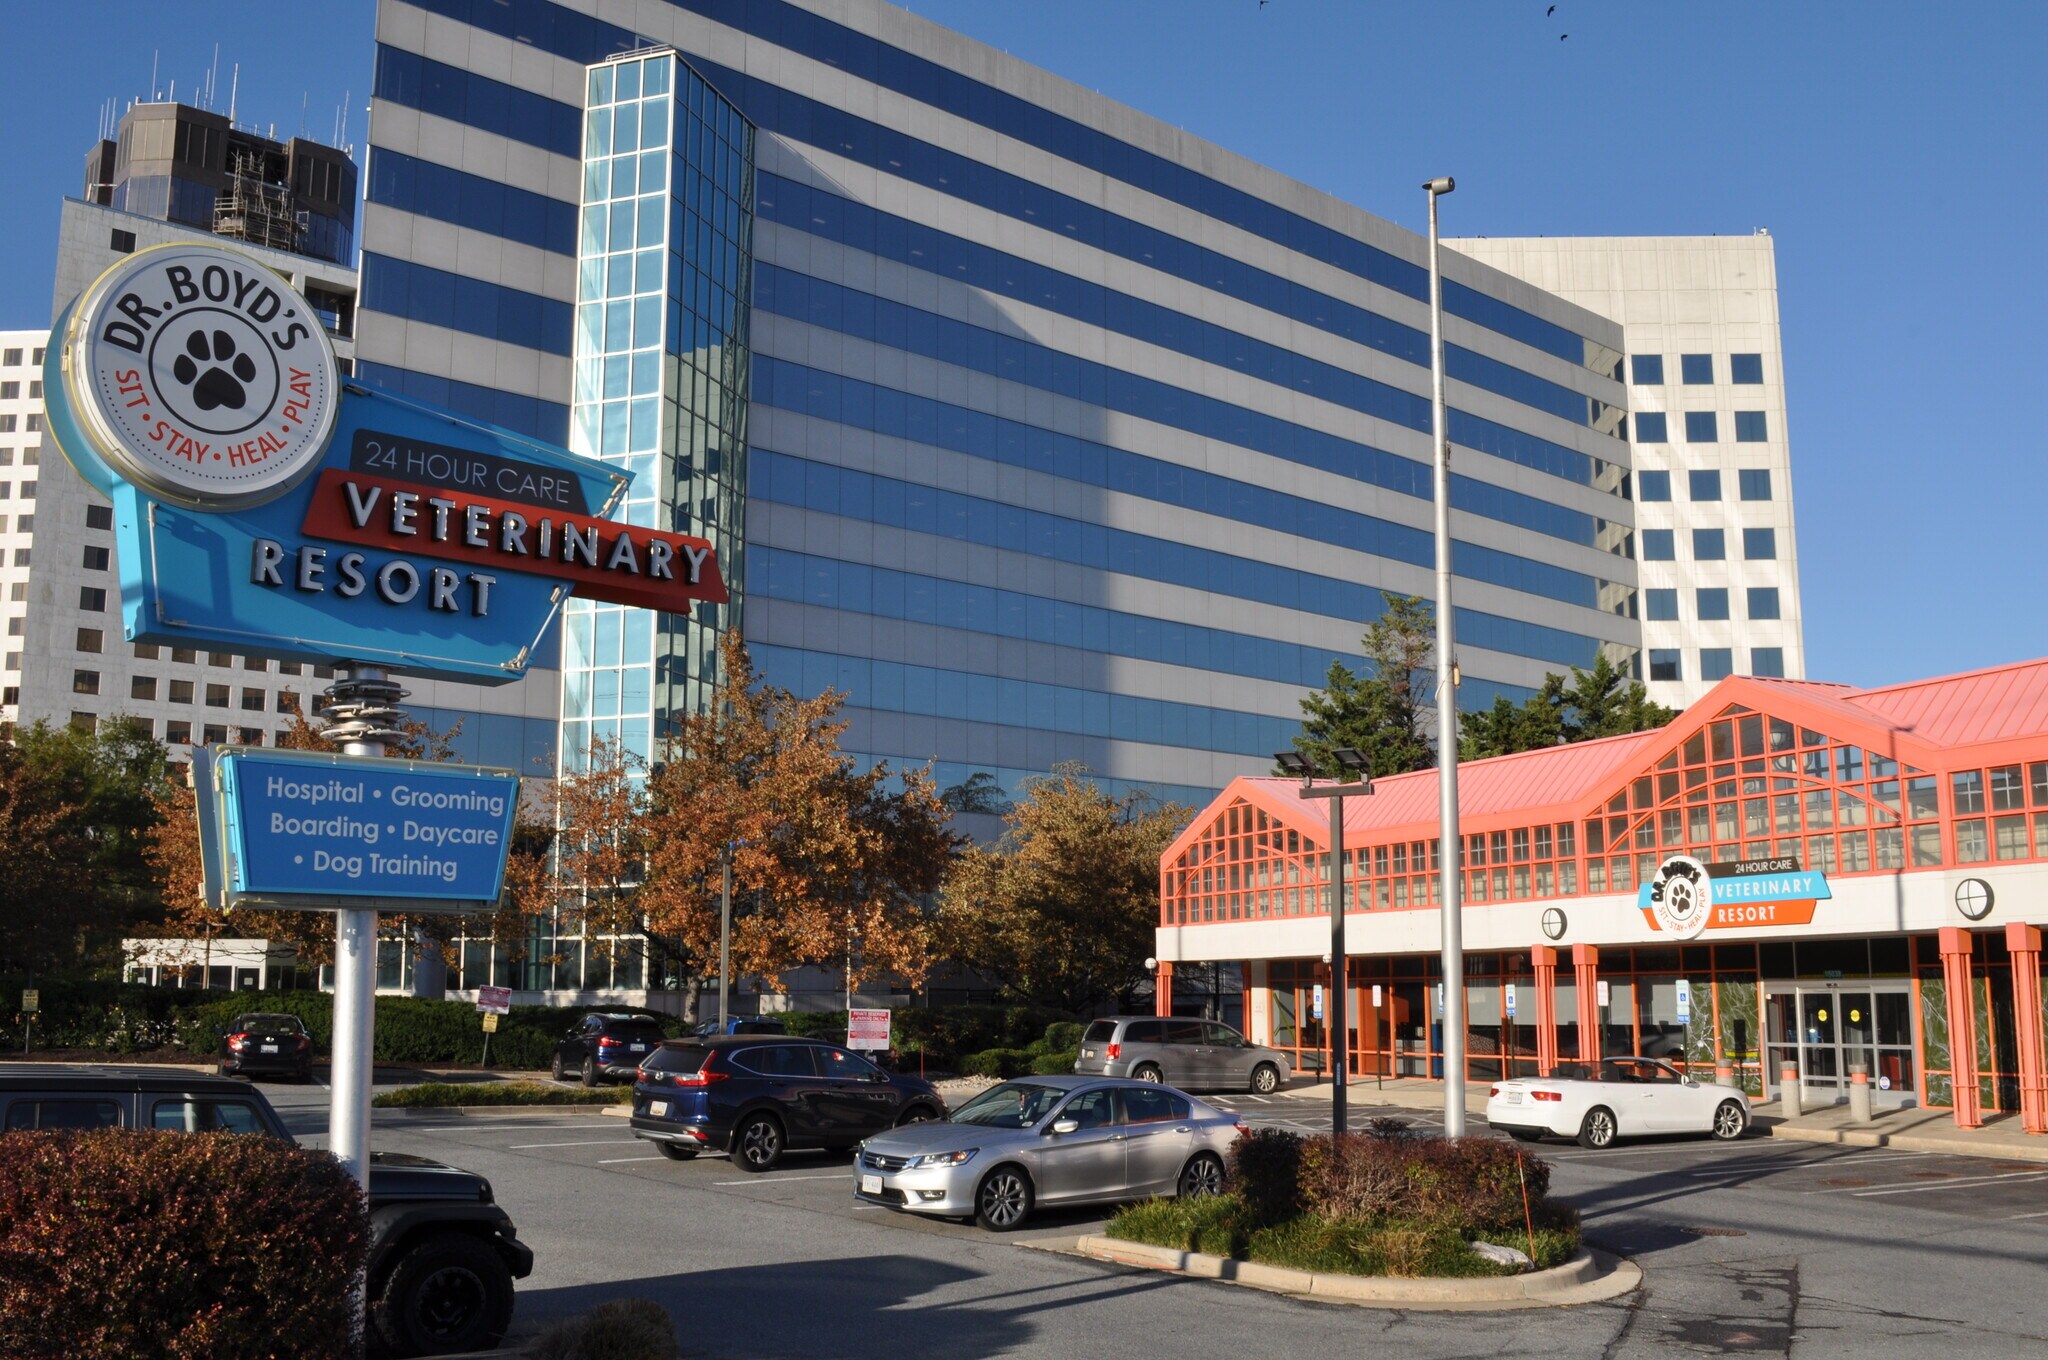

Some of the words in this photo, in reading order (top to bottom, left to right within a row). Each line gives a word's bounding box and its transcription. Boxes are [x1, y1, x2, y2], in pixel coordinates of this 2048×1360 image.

[115, 369, 151, 408] SIT
[148, 421, 210, 465] STAY
[228, 432, 288, 468] HEAL
[283, 367, 311, 424] PLAY
[364, 441, 398, 470] 24
[407, 453, 488, 488] HOUR
[496, 468, 570, 504] CARE
[342, 480, 709, 585] VETERINARY
[252, 537, 497, 617] RESORT
[266, 776, 363, 805] Hospital
[391, 785, 504, 817] Grooming
[270, 812, 379, 844] Boarding
[403, 820, 498, 847] Daycare
[313, 850, 363, 878] Dog
[369, 853, 457, 881] Training
[1735, 864, 1745, 874] 24
[1746, 861, 1768, 873] HOUR
[1769, 859, 1792, 871] CARE
[1715, 877, 1812, 898] VETERINARY
[1669, 921, 1684, 933] STAY
[1687, 913, 1702, 929] HEAL
[1698, 888, 1706, 908] PLAY
[1717, 905, 1776, 923] RESORT
